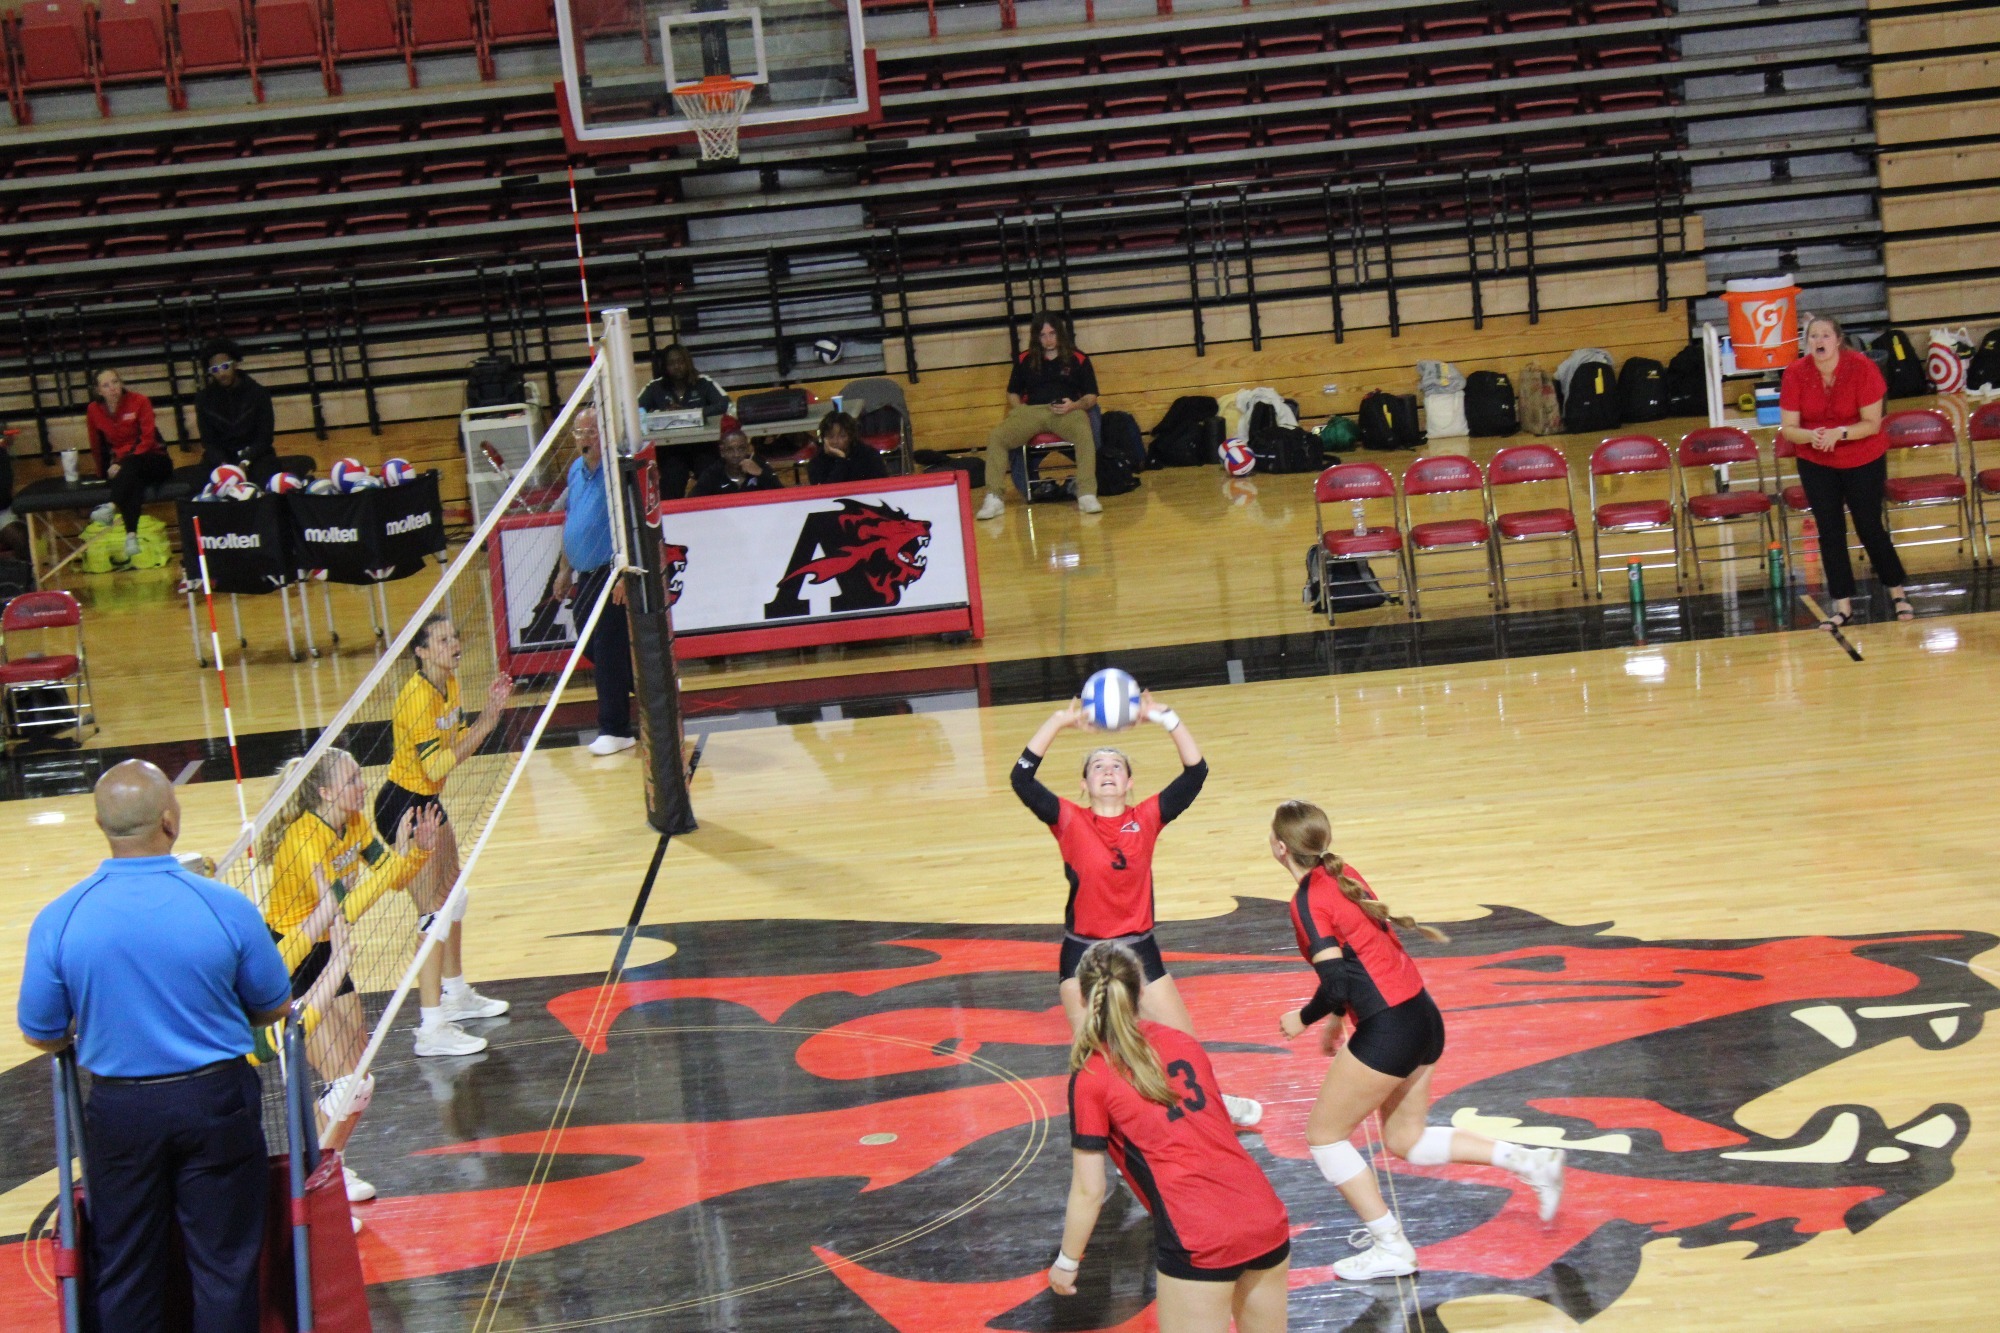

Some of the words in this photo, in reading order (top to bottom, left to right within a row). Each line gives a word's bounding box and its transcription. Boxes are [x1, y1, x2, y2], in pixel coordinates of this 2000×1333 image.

[1756, 304, 1778, 327] G
[304, 526, 359, 543] molten
[387, 511, 432, 536] molten
[200, 533, 261, 550] molten
[1111, 847, 1127, 870] 3
